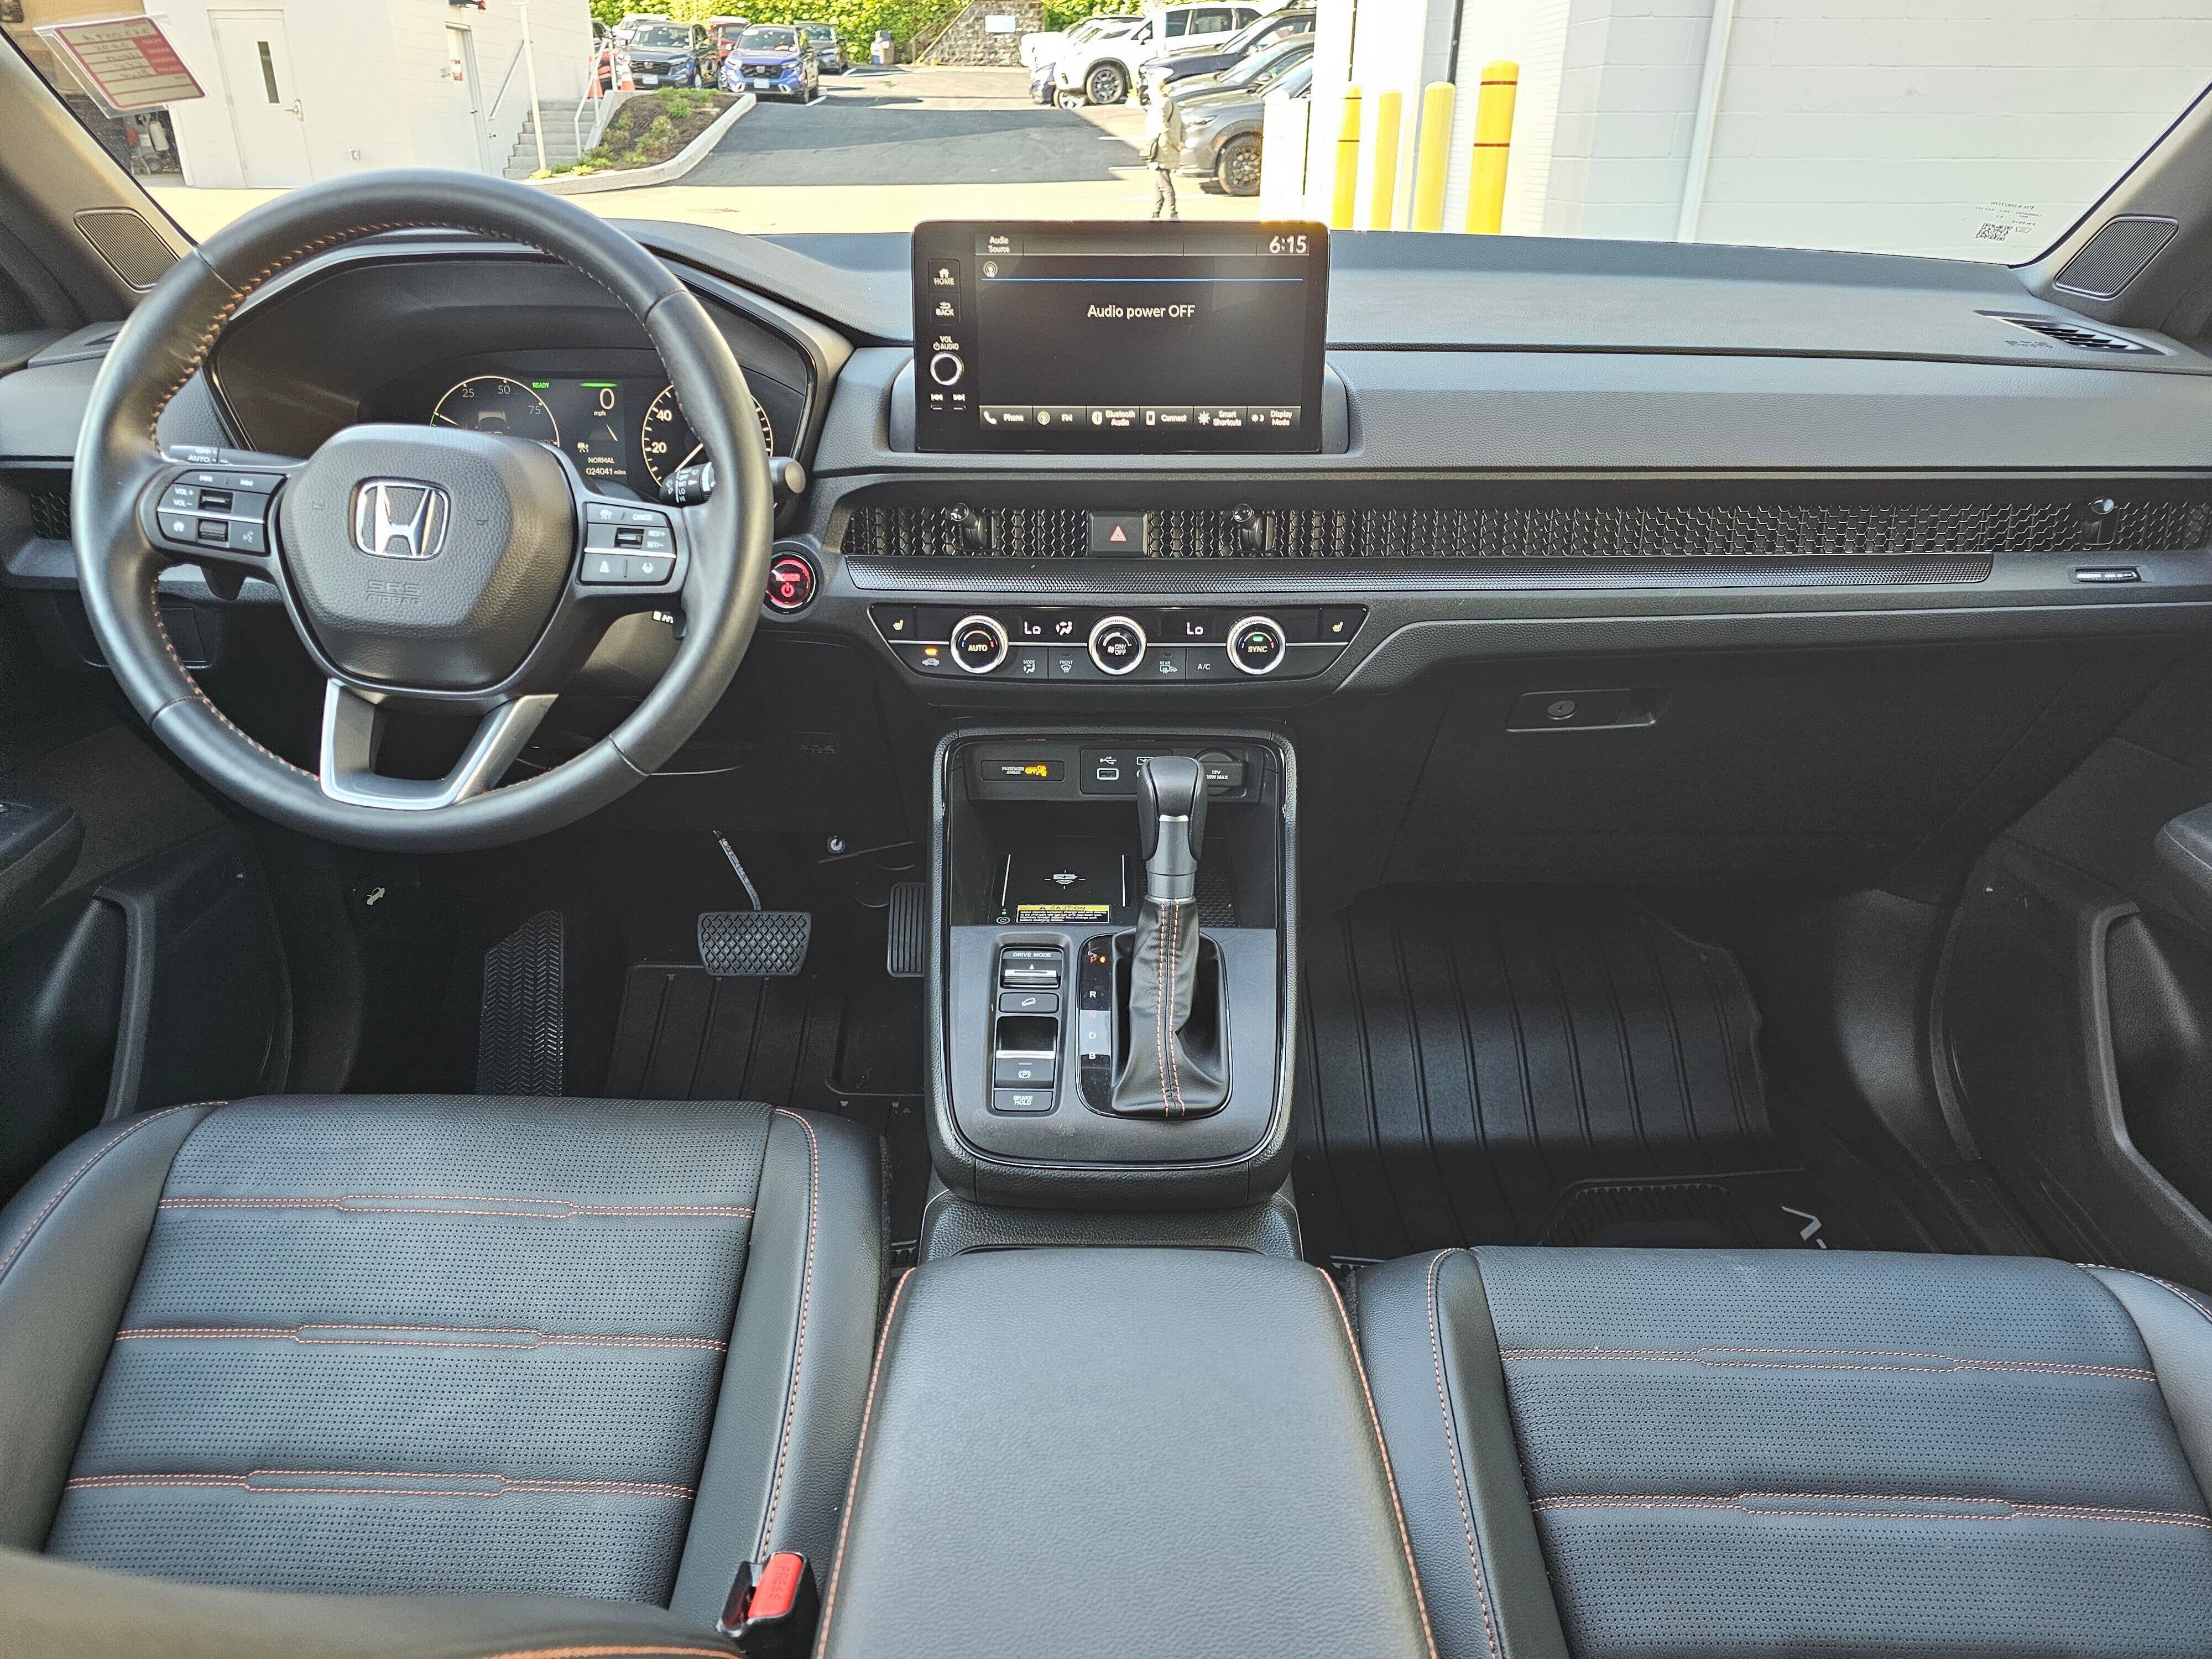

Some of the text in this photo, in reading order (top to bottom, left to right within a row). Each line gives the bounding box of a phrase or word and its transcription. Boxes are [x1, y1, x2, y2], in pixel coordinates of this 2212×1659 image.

[989, 236, 1009, 244] Audio
[1269, 235, 1307, 254] 6:15
[988, 245, 1010, 253] Source
[1087, 305, 1196, 320] Audio power OFF
[462, 389, 474, 398] 25
[498, 385, 510, 394] 50
[599, 388, 614, 409] 0
[528, 405, 541, 415] 75
[1106, 410, 1136, 419] Bluetooth
[1218, 410, 1237, 419] Smart
[1270, 410, 1292, 419] Display
[656, 410, 672, 421] 40
[1003, 414, 1024, 422] Phone
[1161, 414, 1187, 422] Connect
[651, 442, 666, 453] 20
[188, 455, 210, 463] AUTO
[367, 580, 420, 594] SRS
[366, 593, 422, 606] AIRBAG
